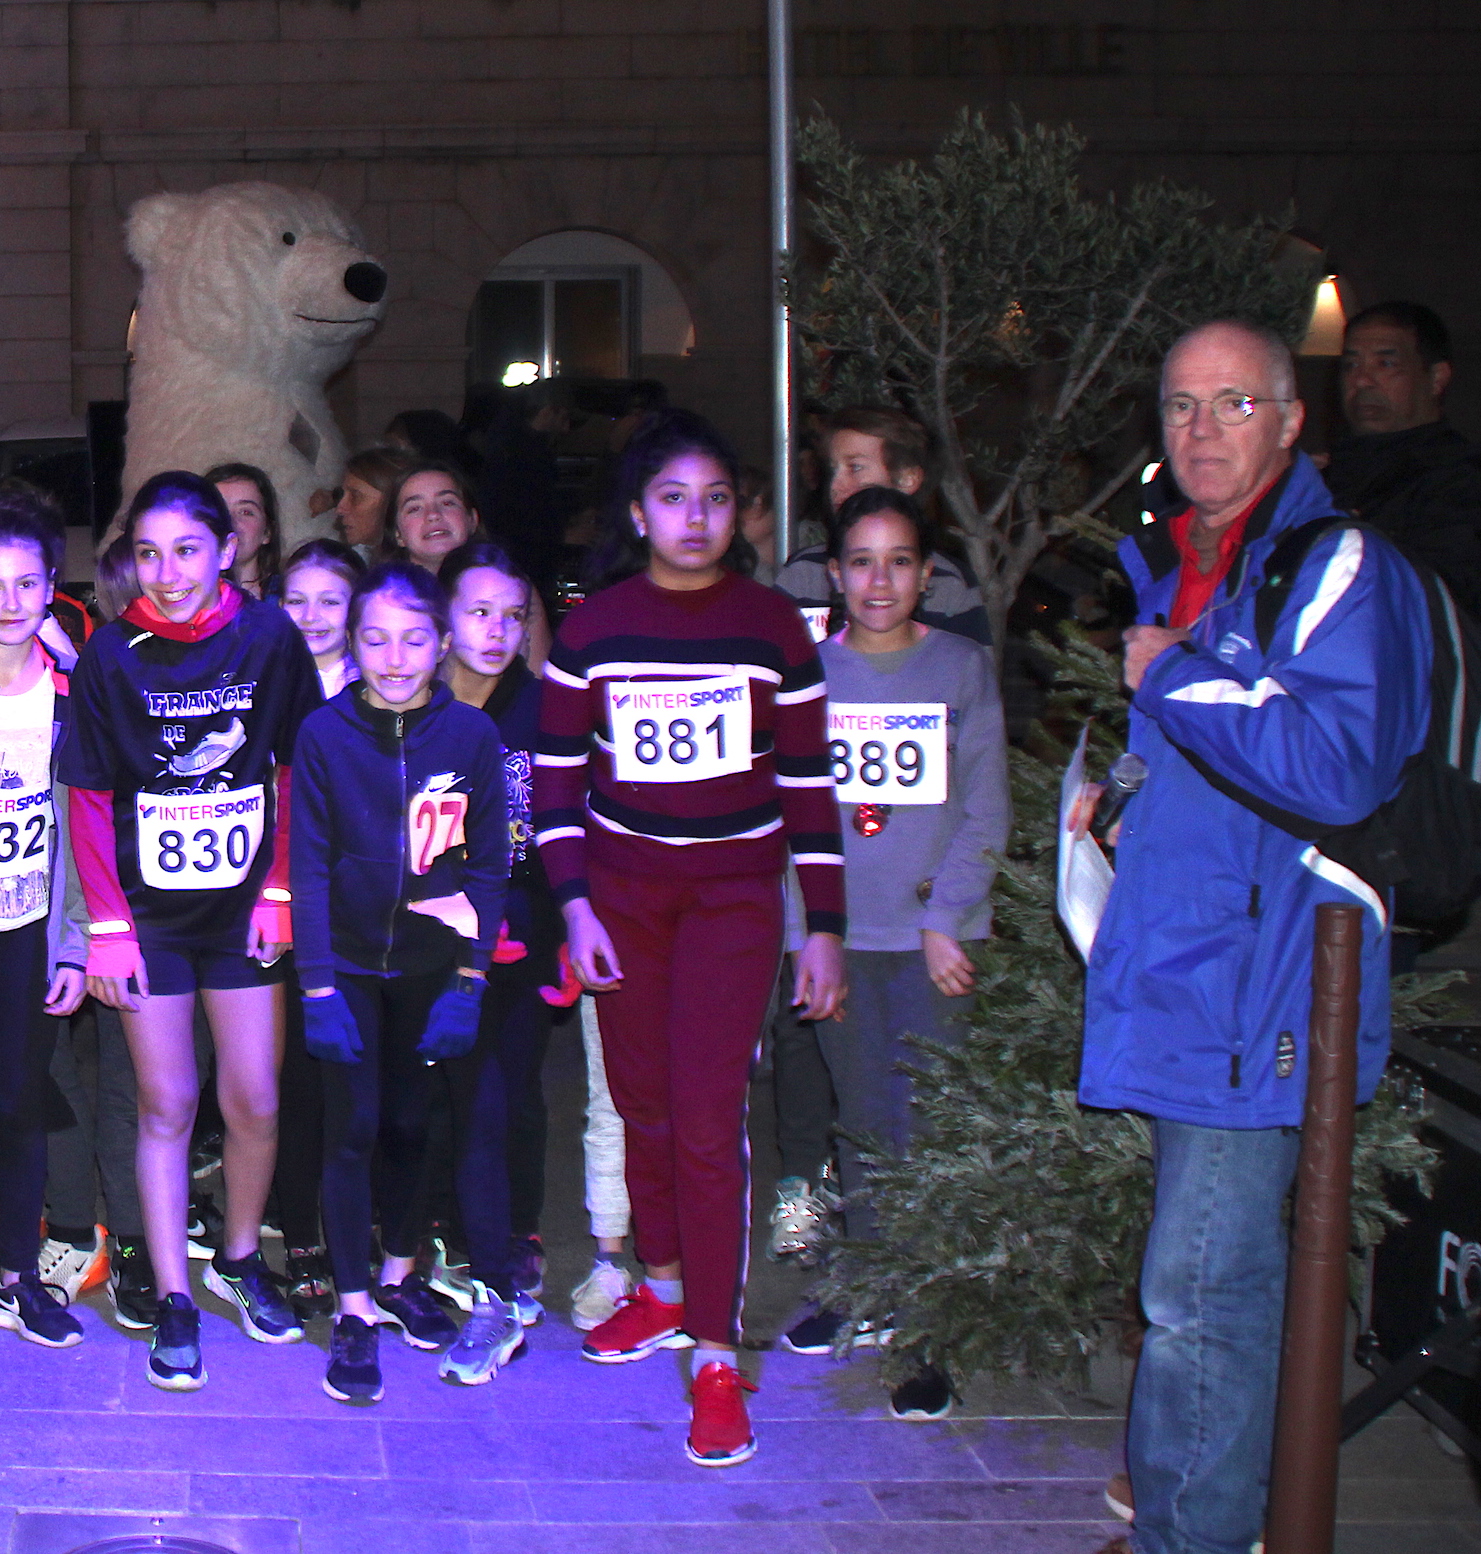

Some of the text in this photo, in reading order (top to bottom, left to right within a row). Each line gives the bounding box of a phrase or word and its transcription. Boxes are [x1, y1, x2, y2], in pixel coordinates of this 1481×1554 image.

[633, 686, 745, 709] INTERSPORT
[162, 724, 187, 743] DE
[634, 713, 726, 766] 881
[829, 714, 942, 731] INTERSPORT
[829, 739, 926, 788] 889
[158, 796, 261, 821] INTERSPORT
[157, 824, 250, 874] 830
[416, 800, 462, 875] 27
